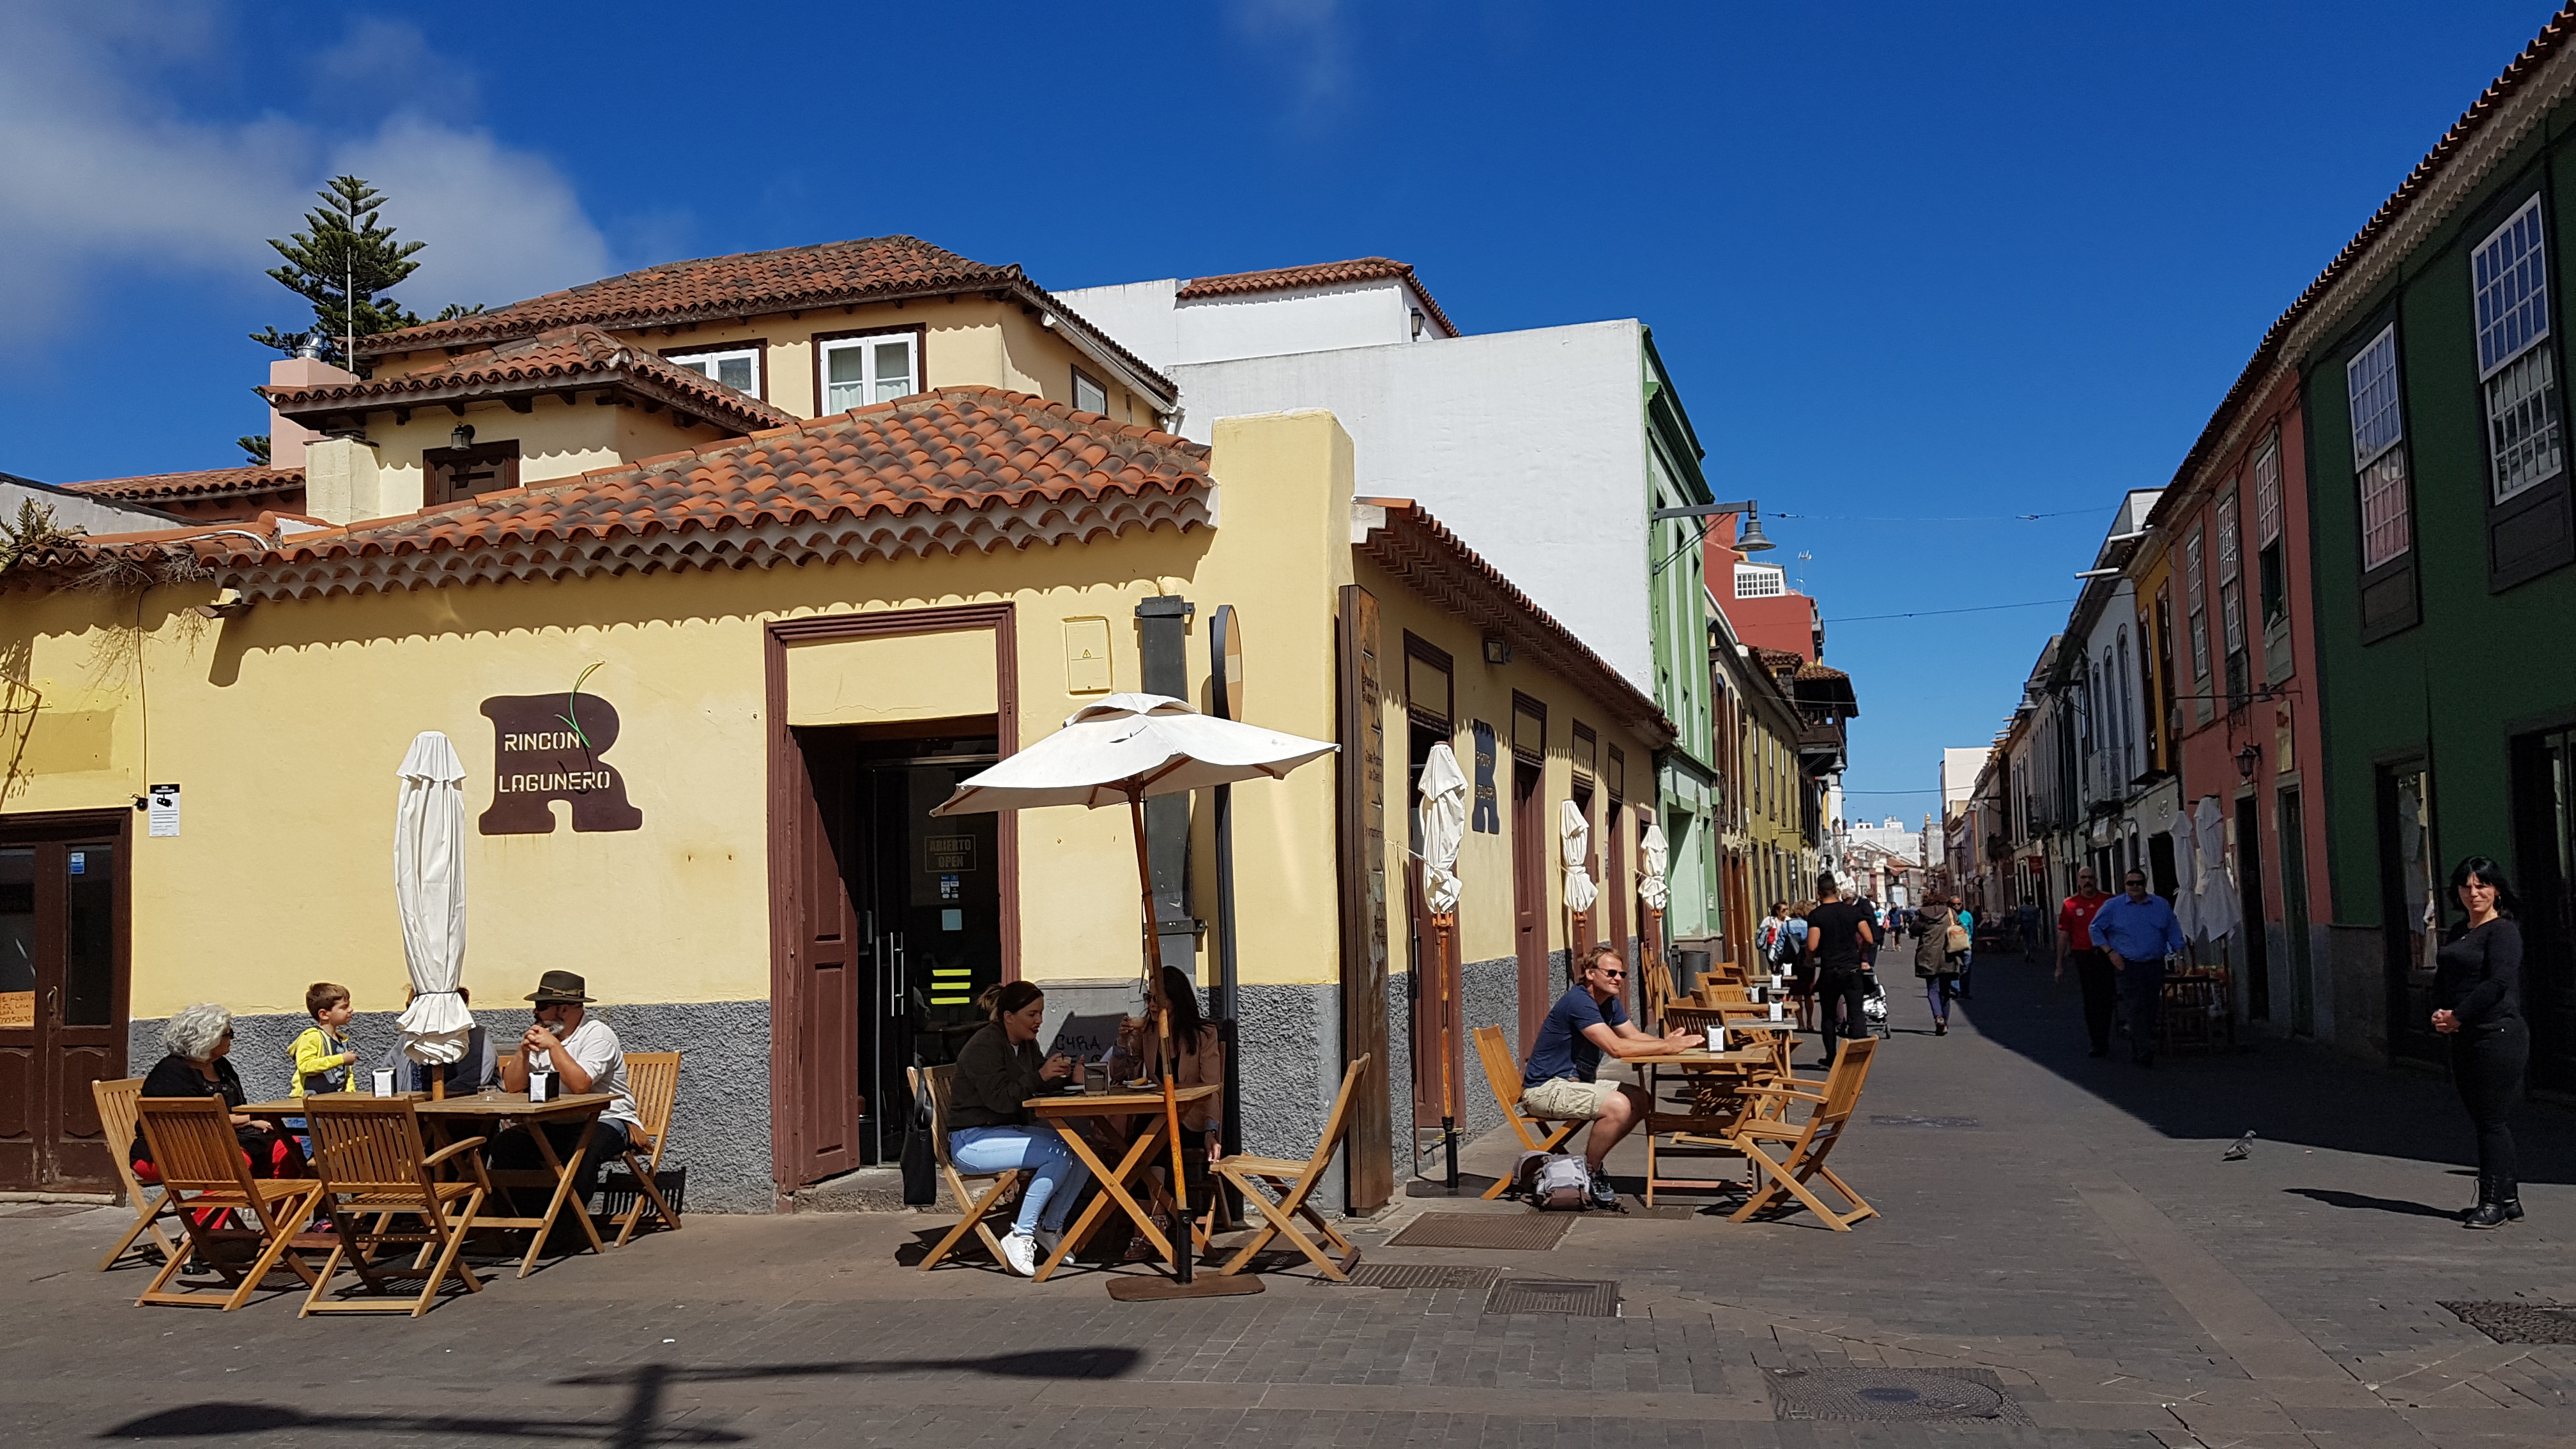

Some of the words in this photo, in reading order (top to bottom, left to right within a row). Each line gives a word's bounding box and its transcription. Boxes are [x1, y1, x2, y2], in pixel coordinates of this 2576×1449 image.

[504, 731, 581, 752] RINCON
[498, 770, 611, 793] LAGUNERO
[930, 839, 971, 852] ABIERTO
[938, 855, 963, 868] OPEN
